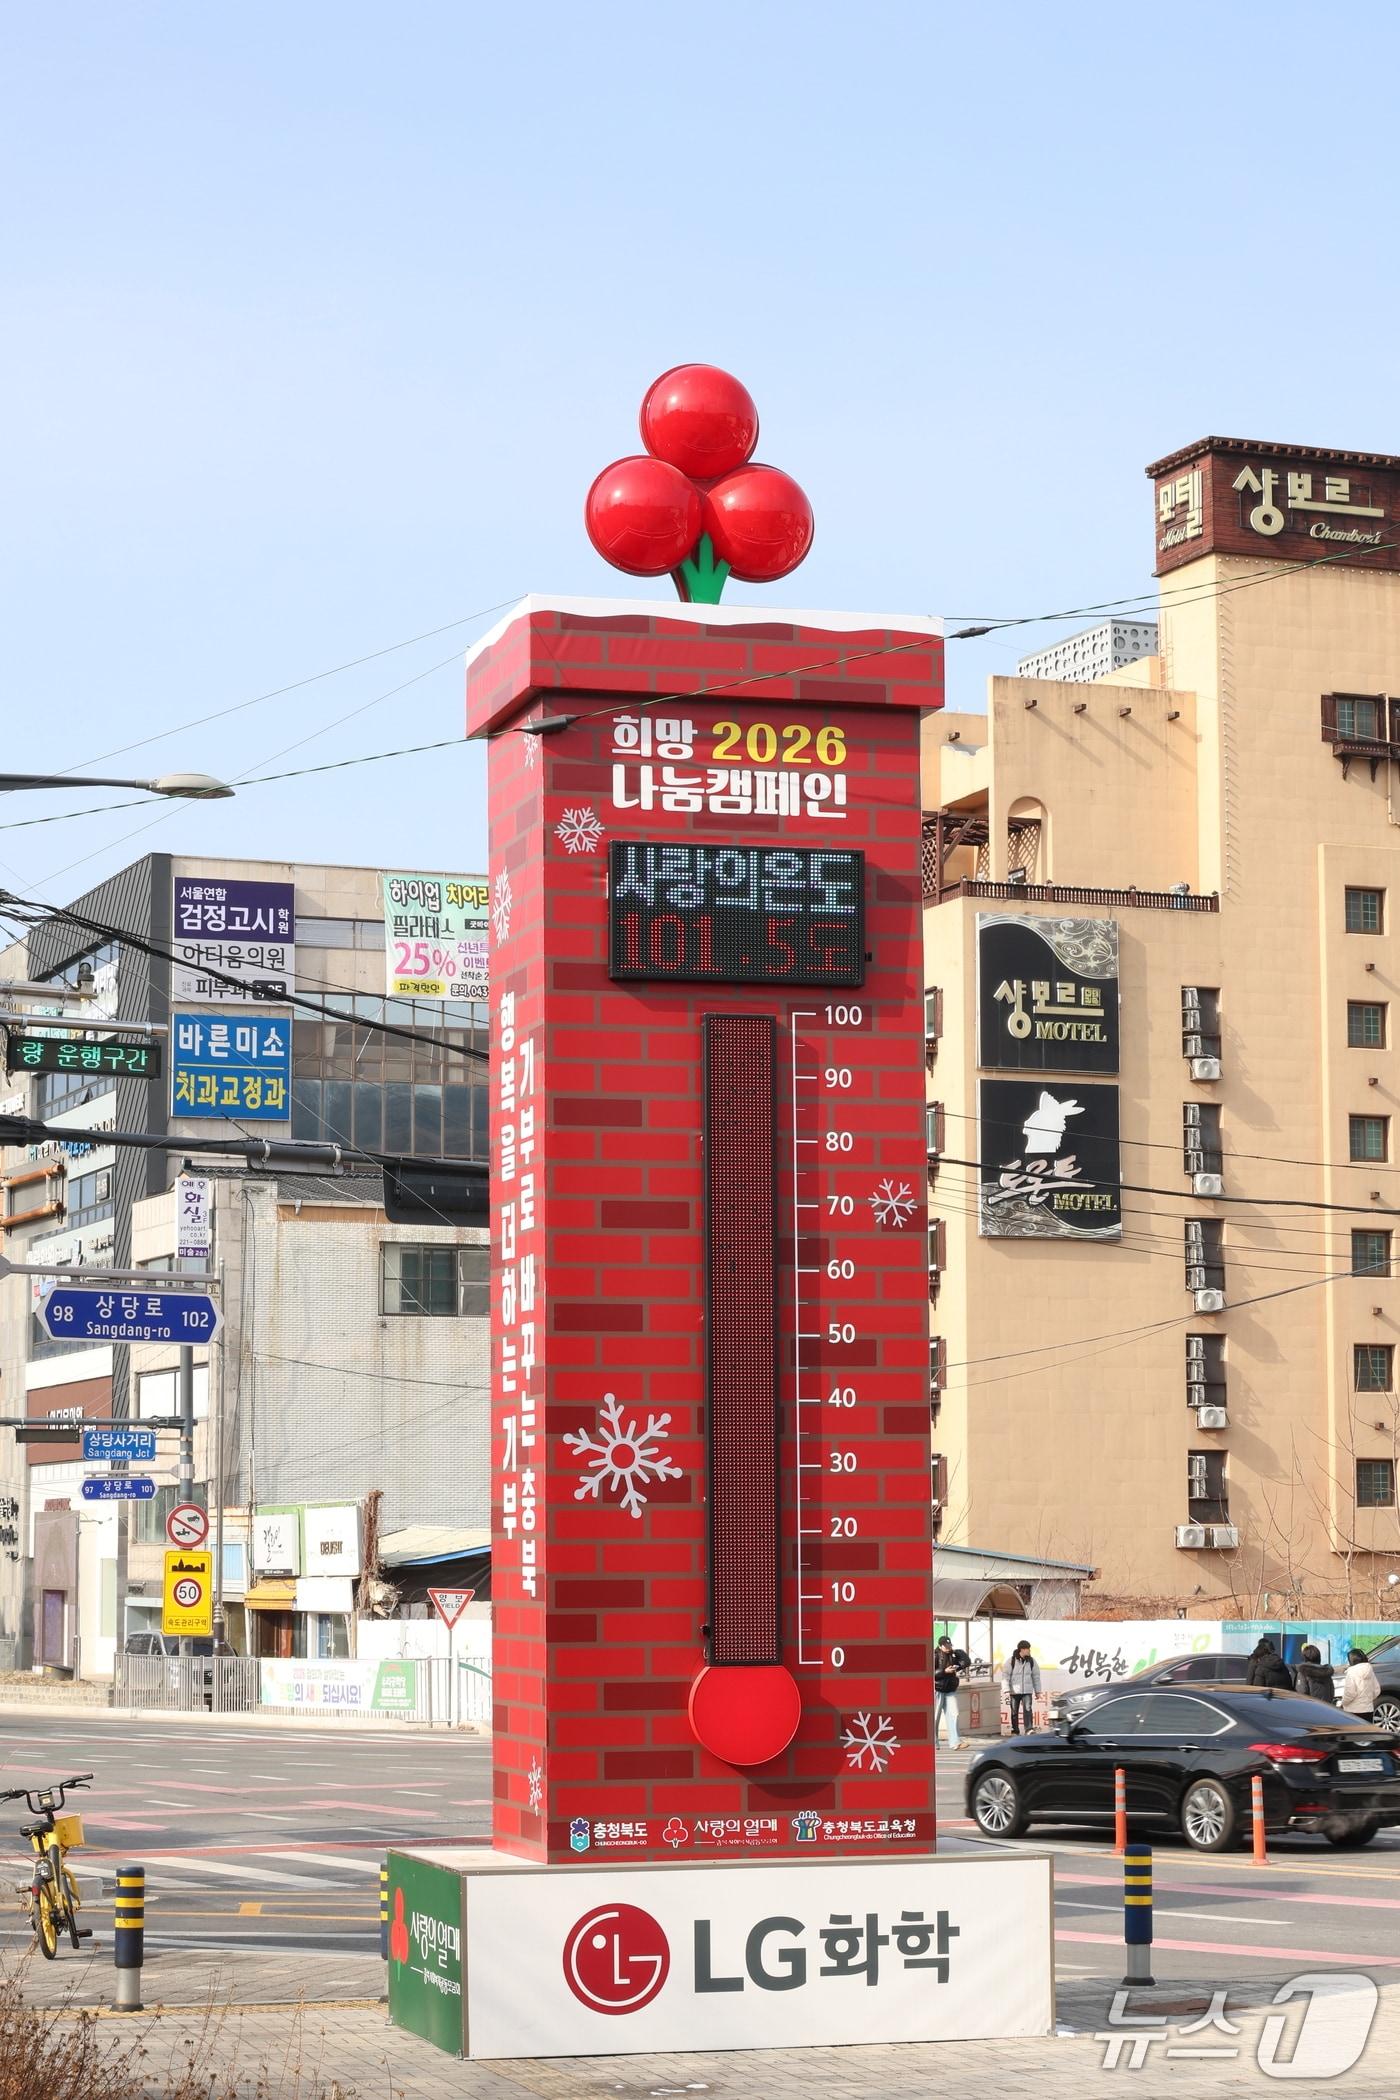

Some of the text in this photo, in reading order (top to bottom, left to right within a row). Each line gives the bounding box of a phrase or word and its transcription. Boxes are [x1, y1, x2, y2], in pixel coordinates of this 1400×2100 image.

[1160, 470, 1203, 539] 모텔
[1232, 465, 1384, 536] 샹보르
[612, 715, 847, 766] 희망 2026
[612, 764, 847, 818] 나눔캠페인
[616, 847, 855, 913] 사랑의온도
[180, 886, 228, 901] 서울연합
[390, 879, 441, 913] 하이업
[180, 904, 290, 934] 검정고시 학원
[394, 915, 455, 940] 필라테스
[394, 942, 456, 977] 25%
[464, 957, 489, 969] 이벤
[826, 1006, 862, 1026] 100
[993, 979, 1105, 1039] 샹보르
[178, 1023, 285, 1059] 바른미소
[1035, 1021, 1107, 1042] MOTEL
[57, 1043, 149, 1073] 운행구간
[825, 1069, 852, 1089] 90
[176, 1071, 286, 1110] 치과교정과
[826, 1132, 853, 1152] 80
[184, 1192, 204, 1223] 화실
[827, 1196, 854, 1216] 70
[1053, 1193, 1117, 1211] MOTEL
[500, 991, 517, 1539] 행복을 더하는 기부
[828, 1260, 855, 1280] 60
[53, 1295, 209, 1328] 98 상당로 102
[520, 1038, 536, 1597] 기부로 바꾸는 충북
[87, 1322, 171, 1339] Sangdang-ro
[829, 1324, 856, 1344] 50
[829, 1388, 856, 1408] 40
[89, 1433, 152, 1448] 상당사거리
[88, 1448, 150, 1459] Sangdang Jct
[830, 1453, 857, 1473] 30
[84, 1481, 153, 1494] 97 상당로 101
[831, 1518, 858, 1538] 20
[179, 1586, 197, 1599] 50
[832, 1582, 856, 1602] 10
[830, 1647, 845, 1668] 0
[1060, 1645, 1130, 1682] 행복한
[593, 1819, 916, 1839] 충청북도 사랑의 열매 충청북도교육청
